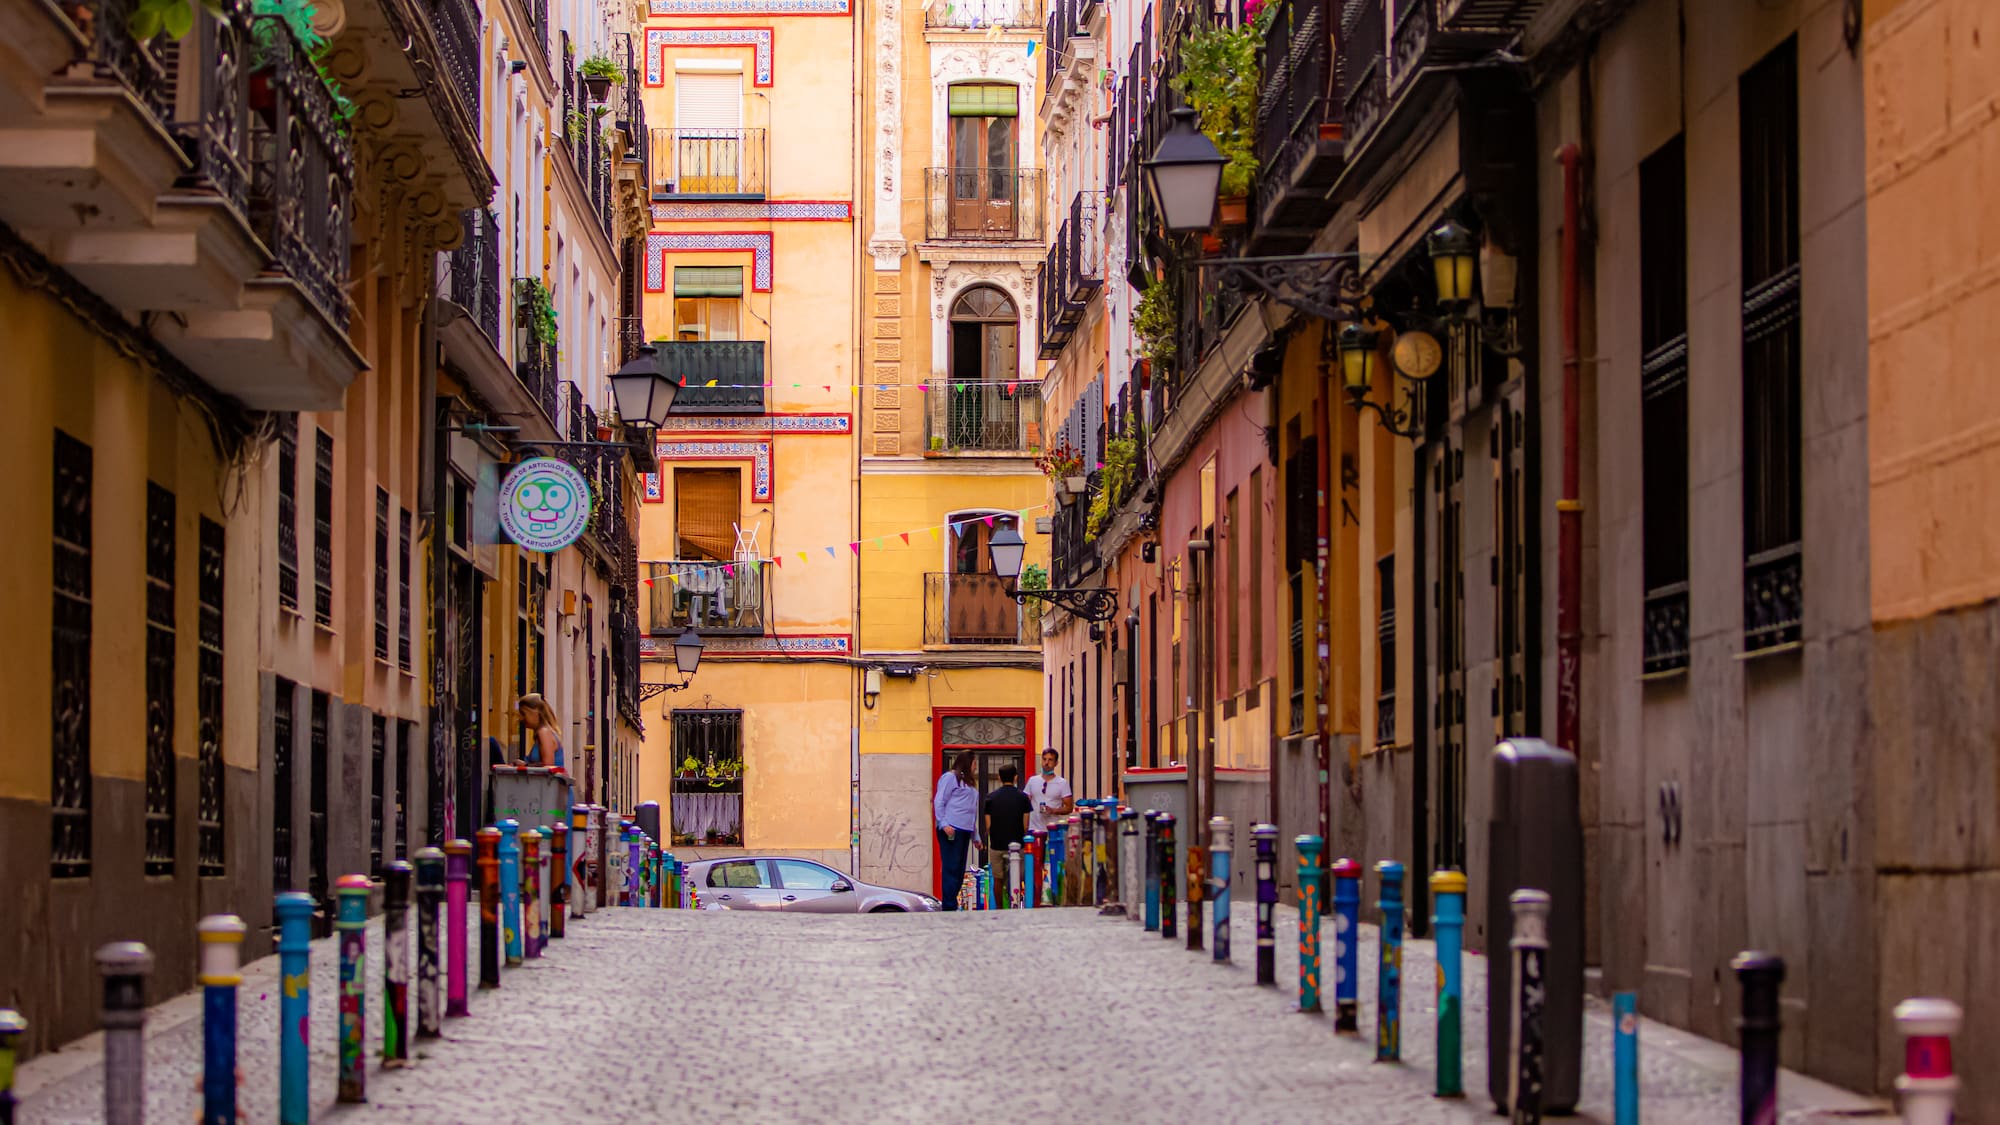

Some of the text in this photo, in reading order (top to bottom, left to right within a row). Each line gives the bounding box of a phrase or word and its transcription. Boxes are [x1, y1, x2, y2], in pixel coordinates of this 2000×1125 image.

[518, 467, 527, 476] DE
[565, 469, 573, 477] DE
[573, 477, 585, 498] FIESTA
[502, 512, 516, 535] TIENDA
[516, 532, 524, 541] DE
[562, 534, 571, 542] DE
[570, 514, 585, 535] FIESTA
